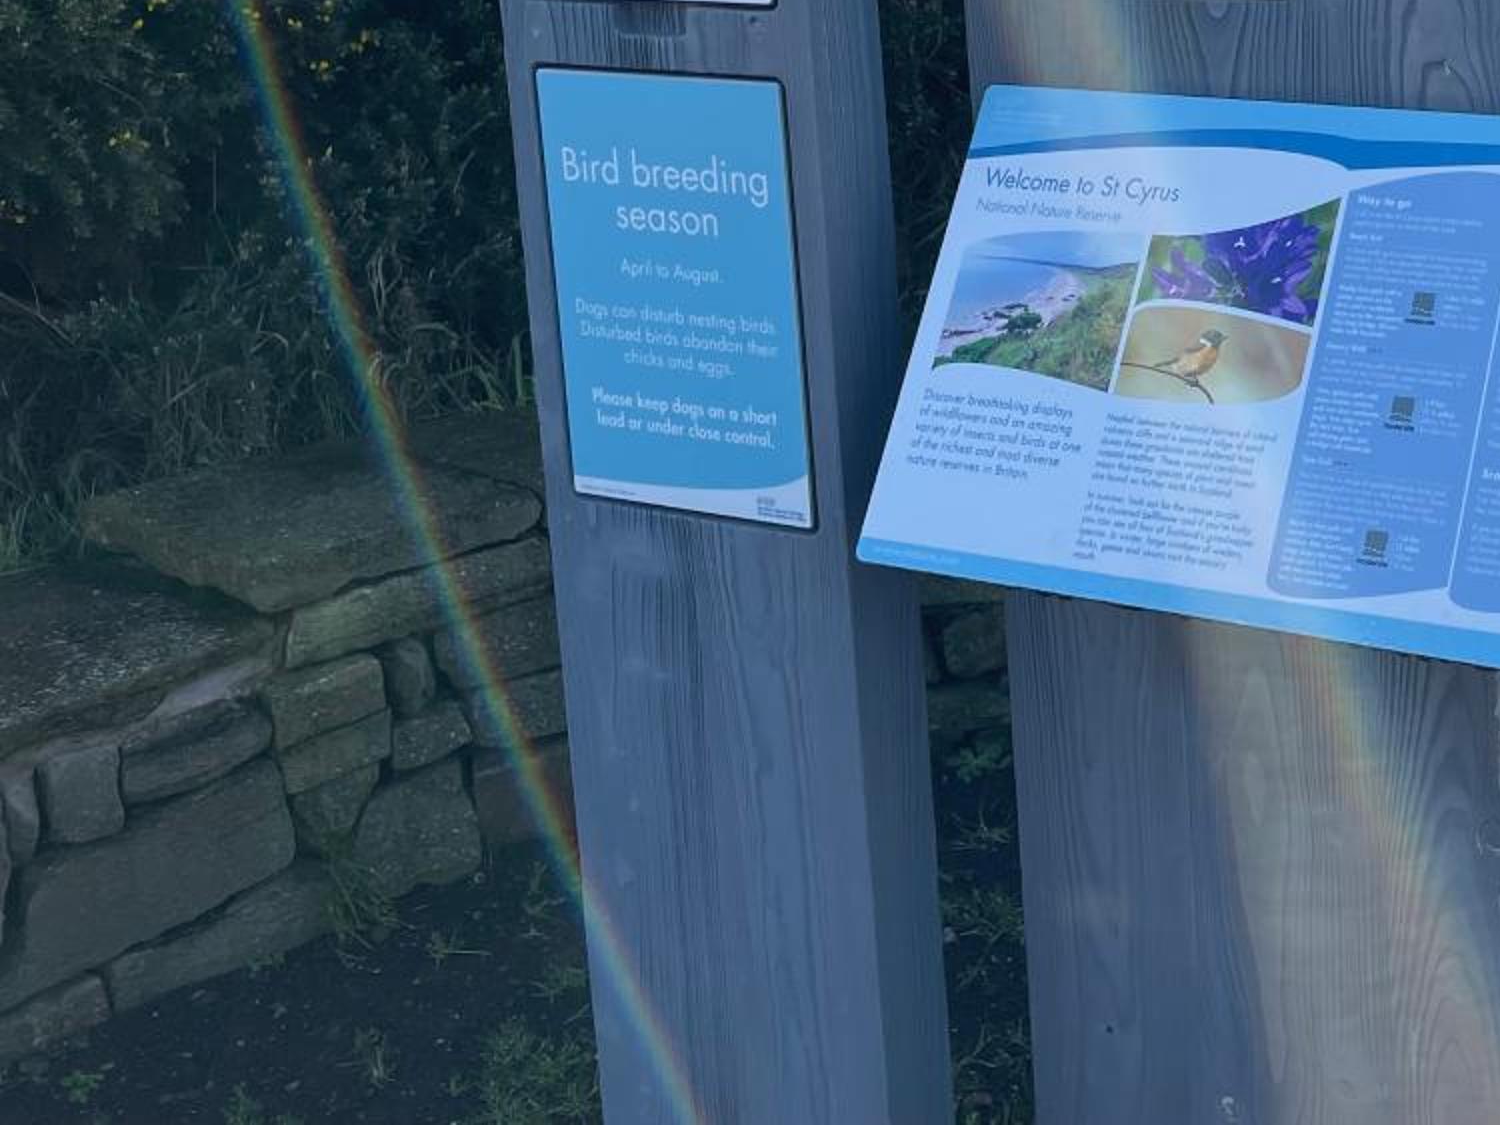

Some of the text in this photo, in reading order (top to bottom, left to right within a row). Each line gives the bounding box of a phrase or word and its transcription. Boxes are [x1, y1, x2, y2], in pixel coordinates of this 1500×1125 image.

[561, 146, 769, 207] Bird breeding
[986, 166, 1182, 207] Welcome to St Cyrus
[615, 203, 719, 237] season
[975, 197, 1122, 223] National Nature Reserve
[621, 257, 653, 278] April
[655, 263, 669, 279] to
[575, 298, 608, 320] Dogs
[612, 305, 637, 319] can
[640, 305, 685, 324] disturb
[689, 312, 737, 335] nesting
[580, 320, 641, 342] Disturbed
[645, 329, 679, 346] birds
[683, 331, 744, 354] abandon
[624, 349, 664, 368] chicks
[668, 354, 693, 371] and
[592, 387, 778, 426] Please keep dogs on a short
[1032, 400, 1073, 421] displays
[597, 409, 626, 428] lead
[628, 418, 643, 431] or
[647, 418, 684, 436] under
[688, 425, 721, 442] close
